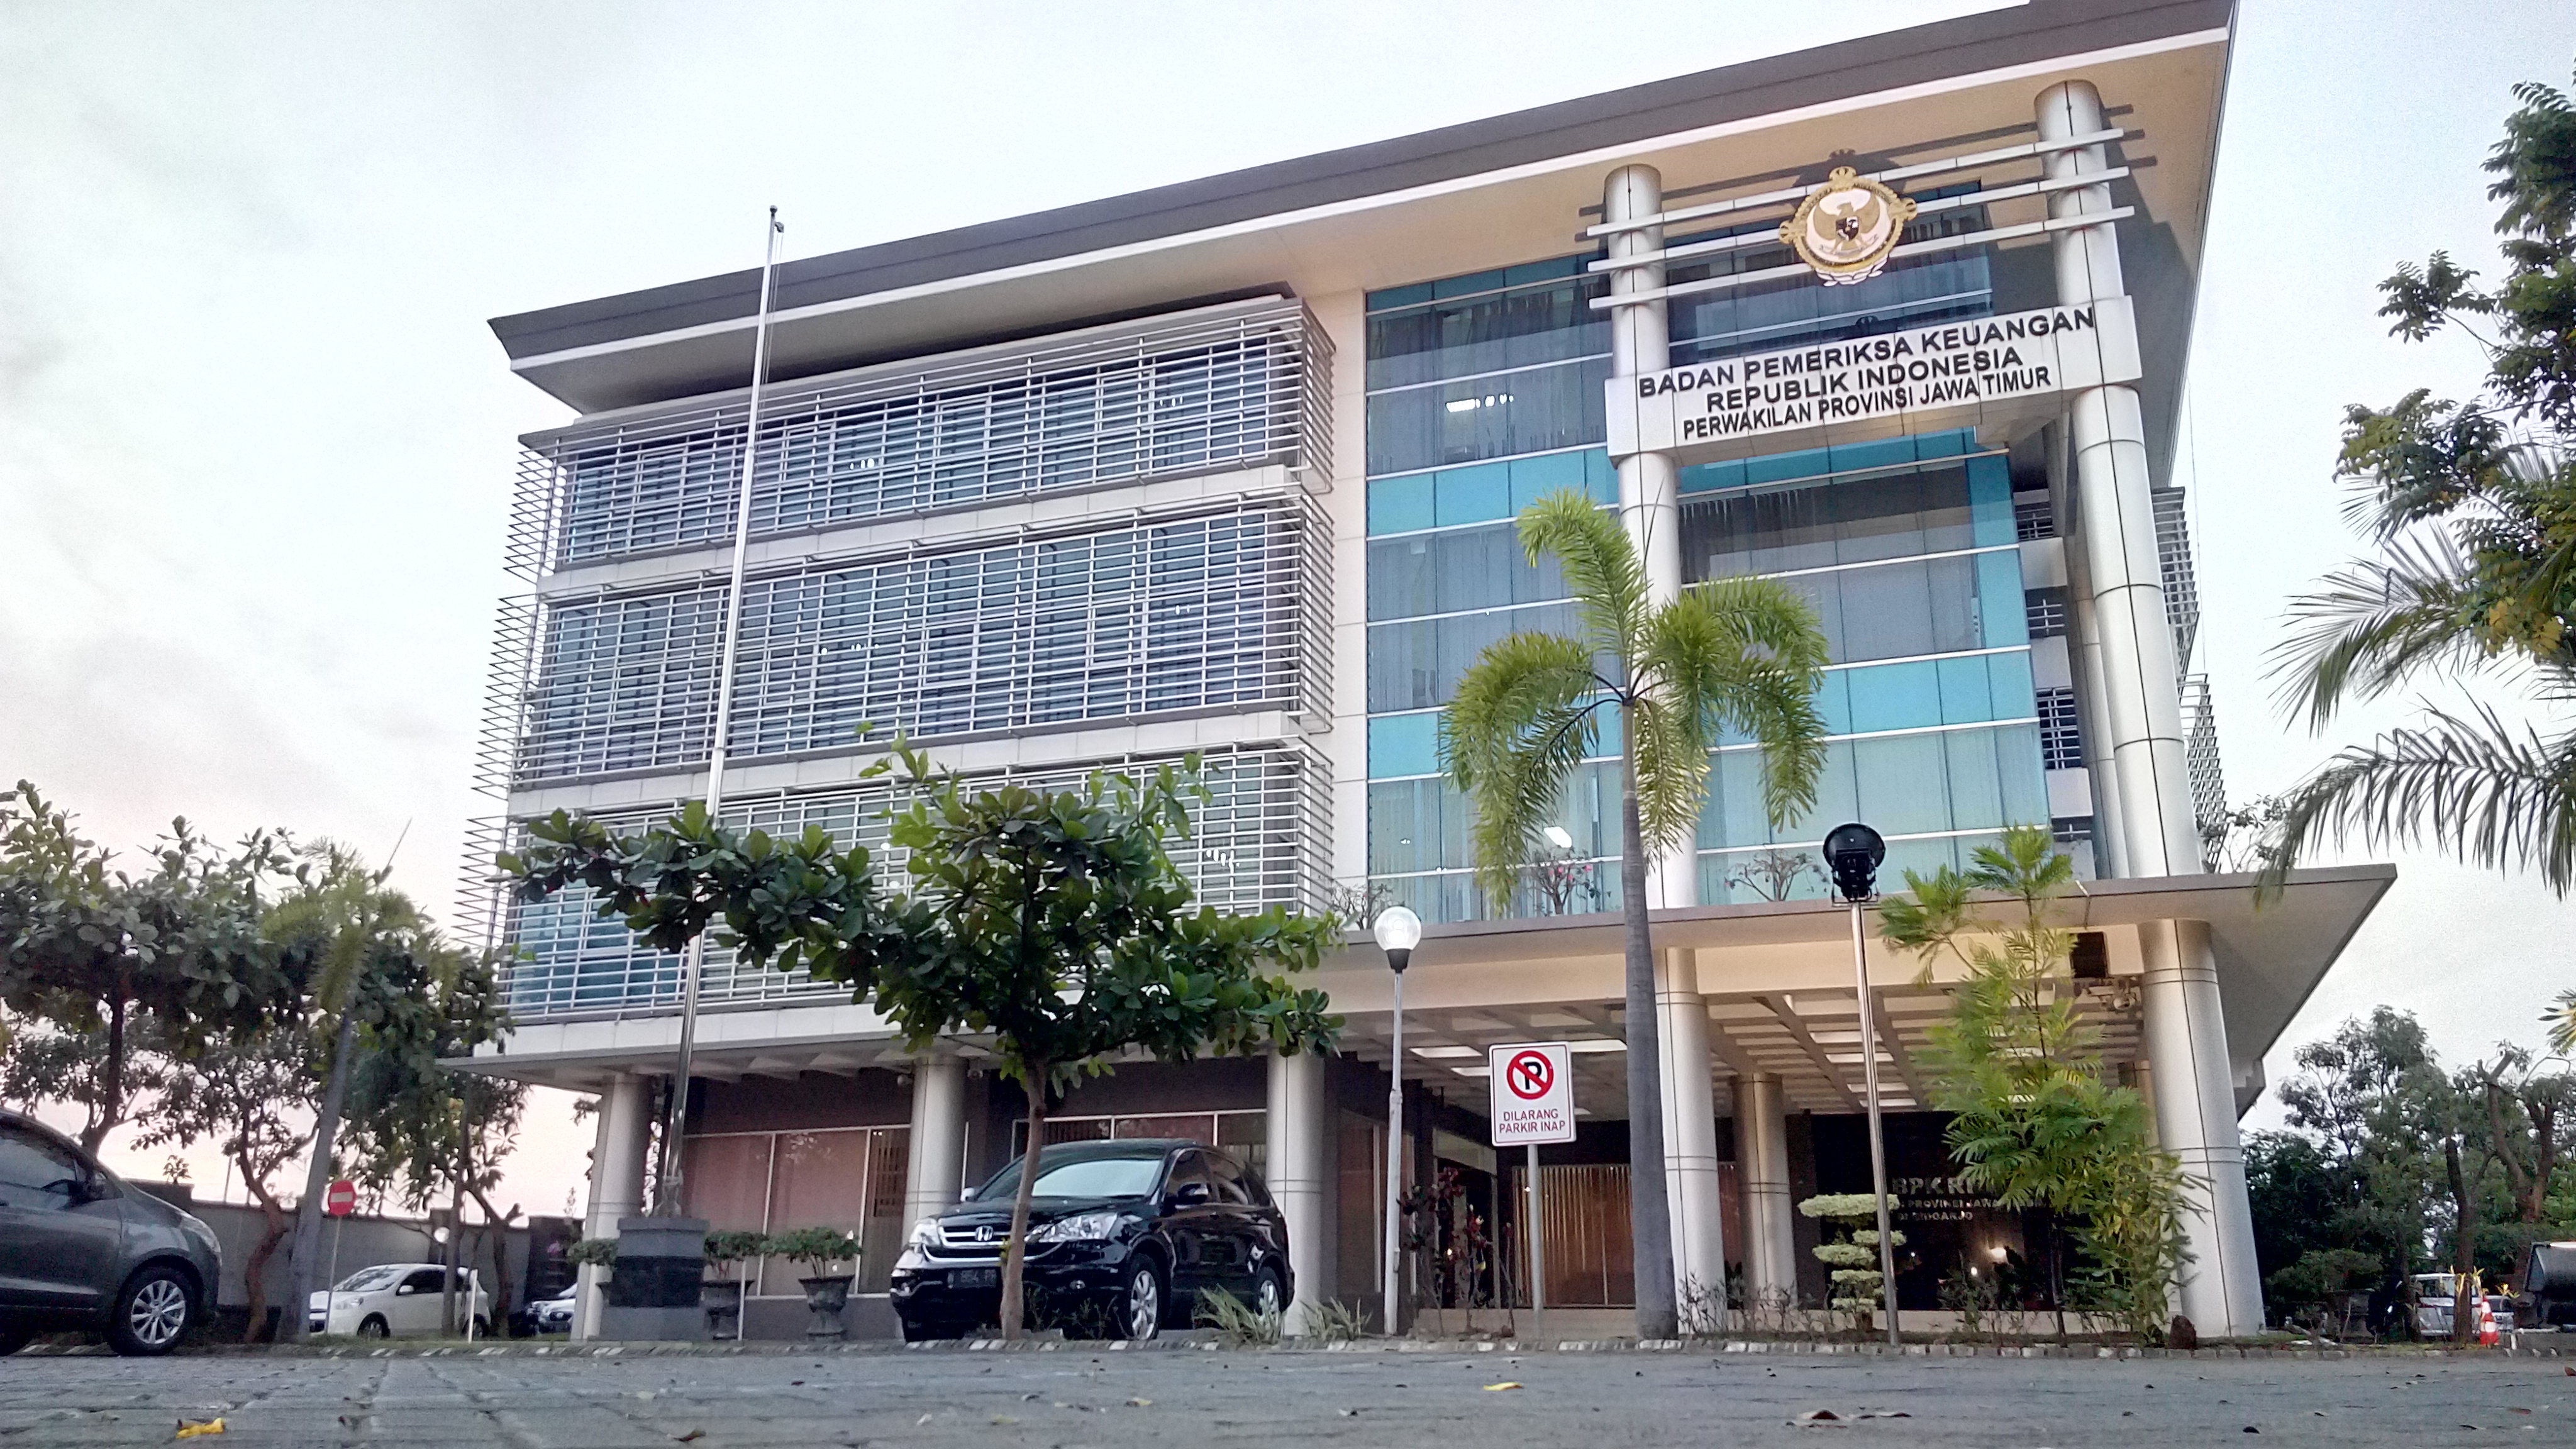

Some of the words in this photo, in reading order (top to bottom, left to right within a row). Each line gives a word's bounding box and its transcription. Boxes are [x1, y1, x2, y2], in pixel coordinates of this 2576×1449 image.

[1639, 364, 1734, 397] BADAN
[1744, 336, 1914, 380] PEMERIKSA
[1921, 307, 2095, 353] KEUANGAN
[1707, 372, 1849, 413] REPUBLIK
[1858, 347, 2023, 389] INDONESIA
[1684, 401, 1811, 440] PERWAKILAN
[1818, 386, 1914, 420] PROVINSI
[1920, 377, 1980, 404] JAWA
[1982, 366, 2051, 395] TIMUR
[1499, 1122, 1538, 1133] PARKIR
[1541, 1120, 1565, 1131] INAP
[1503, 1109, 1558, 1121] DILARANG
